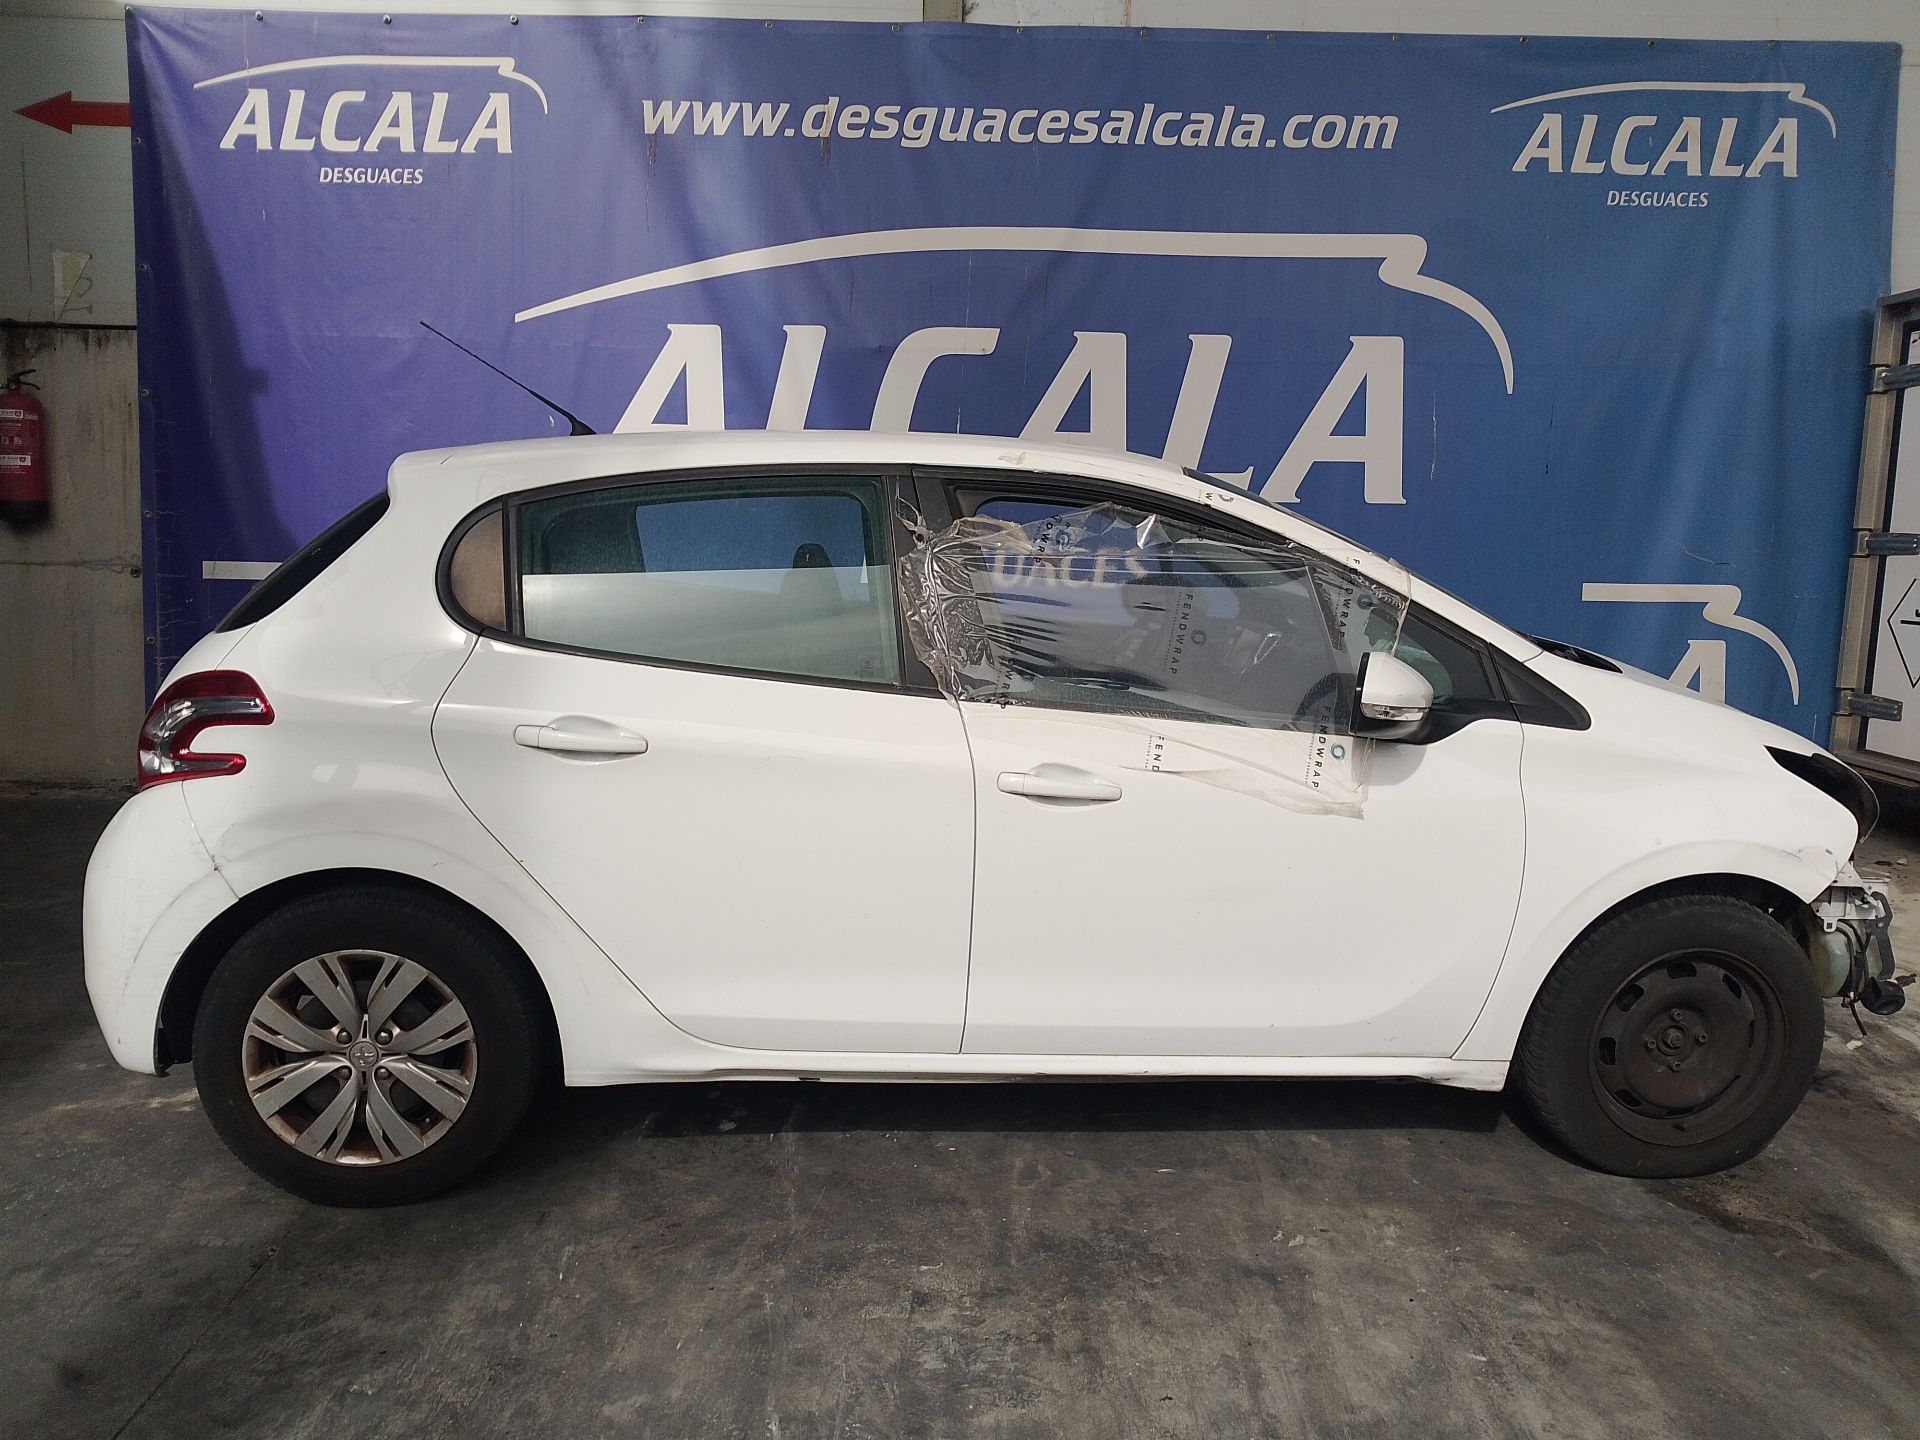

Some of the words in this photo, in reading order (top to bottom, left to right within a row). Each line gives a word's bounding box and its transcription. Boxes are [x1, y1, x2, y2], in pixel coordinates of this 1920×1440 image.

[219, 88, 514, 154] ALCALA
[642, 96, 1399, 149] www.desguacesalcala.com
[1512, 113, 1799, 178] ALCALA
[319, 167, 424, 185] DESGUACES
[1607, 190, 1709, 209] DESGUACES
[1169, 593, 1194, 674] FENDWRAP
[1311, 705, 1332, 788] FENDWRAP
